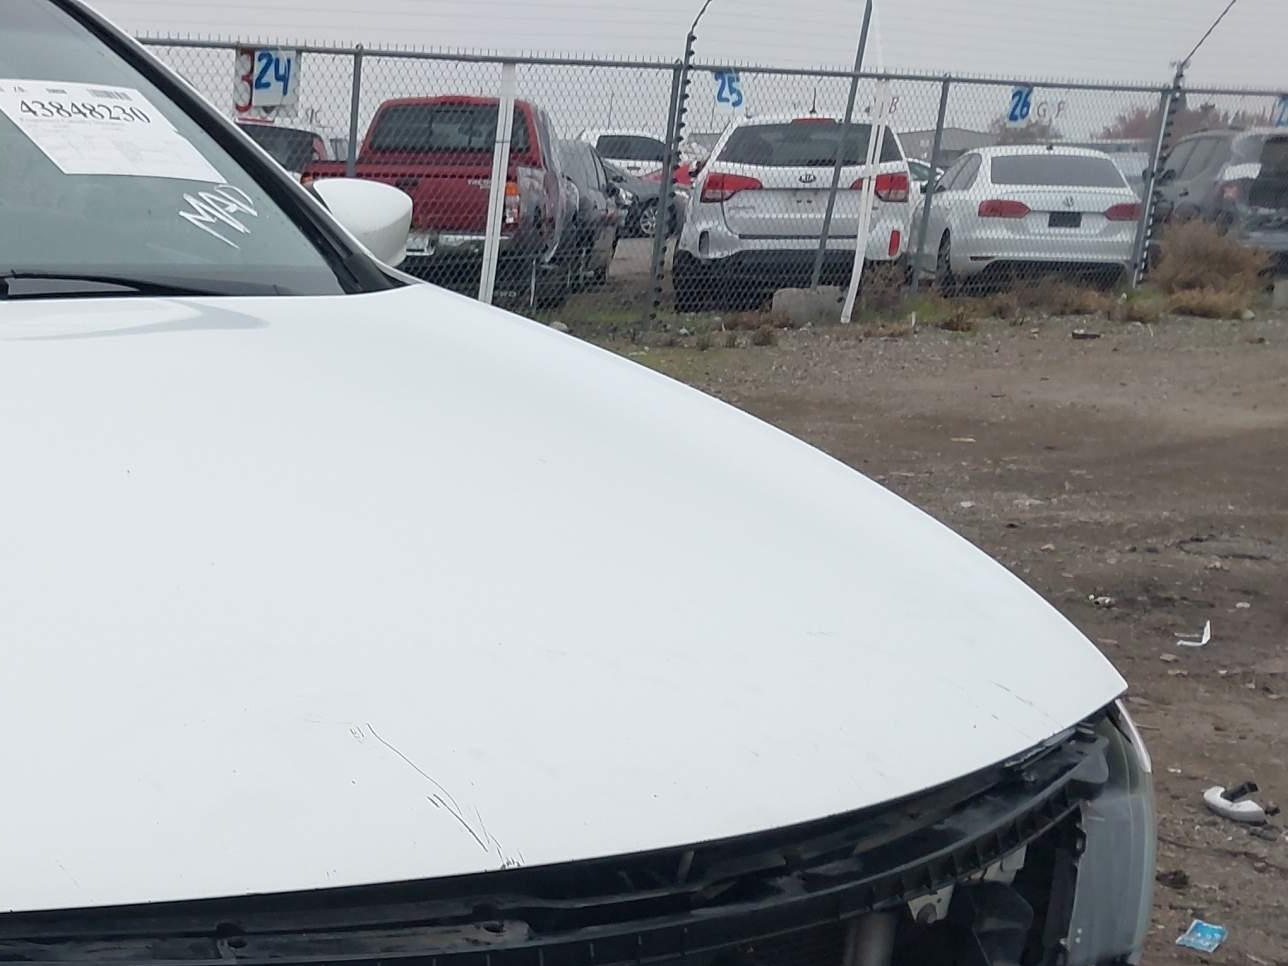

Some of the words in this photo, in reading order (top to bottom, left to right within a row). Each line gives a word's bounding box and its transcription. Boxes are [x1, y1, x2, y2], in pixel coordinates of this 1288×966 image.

[255, 48, 291, 96] 24
[715, 69, 743, 107] 25
[20, 100, 150, 124] 43848230
[1009, 86, 1032, 122] 26
